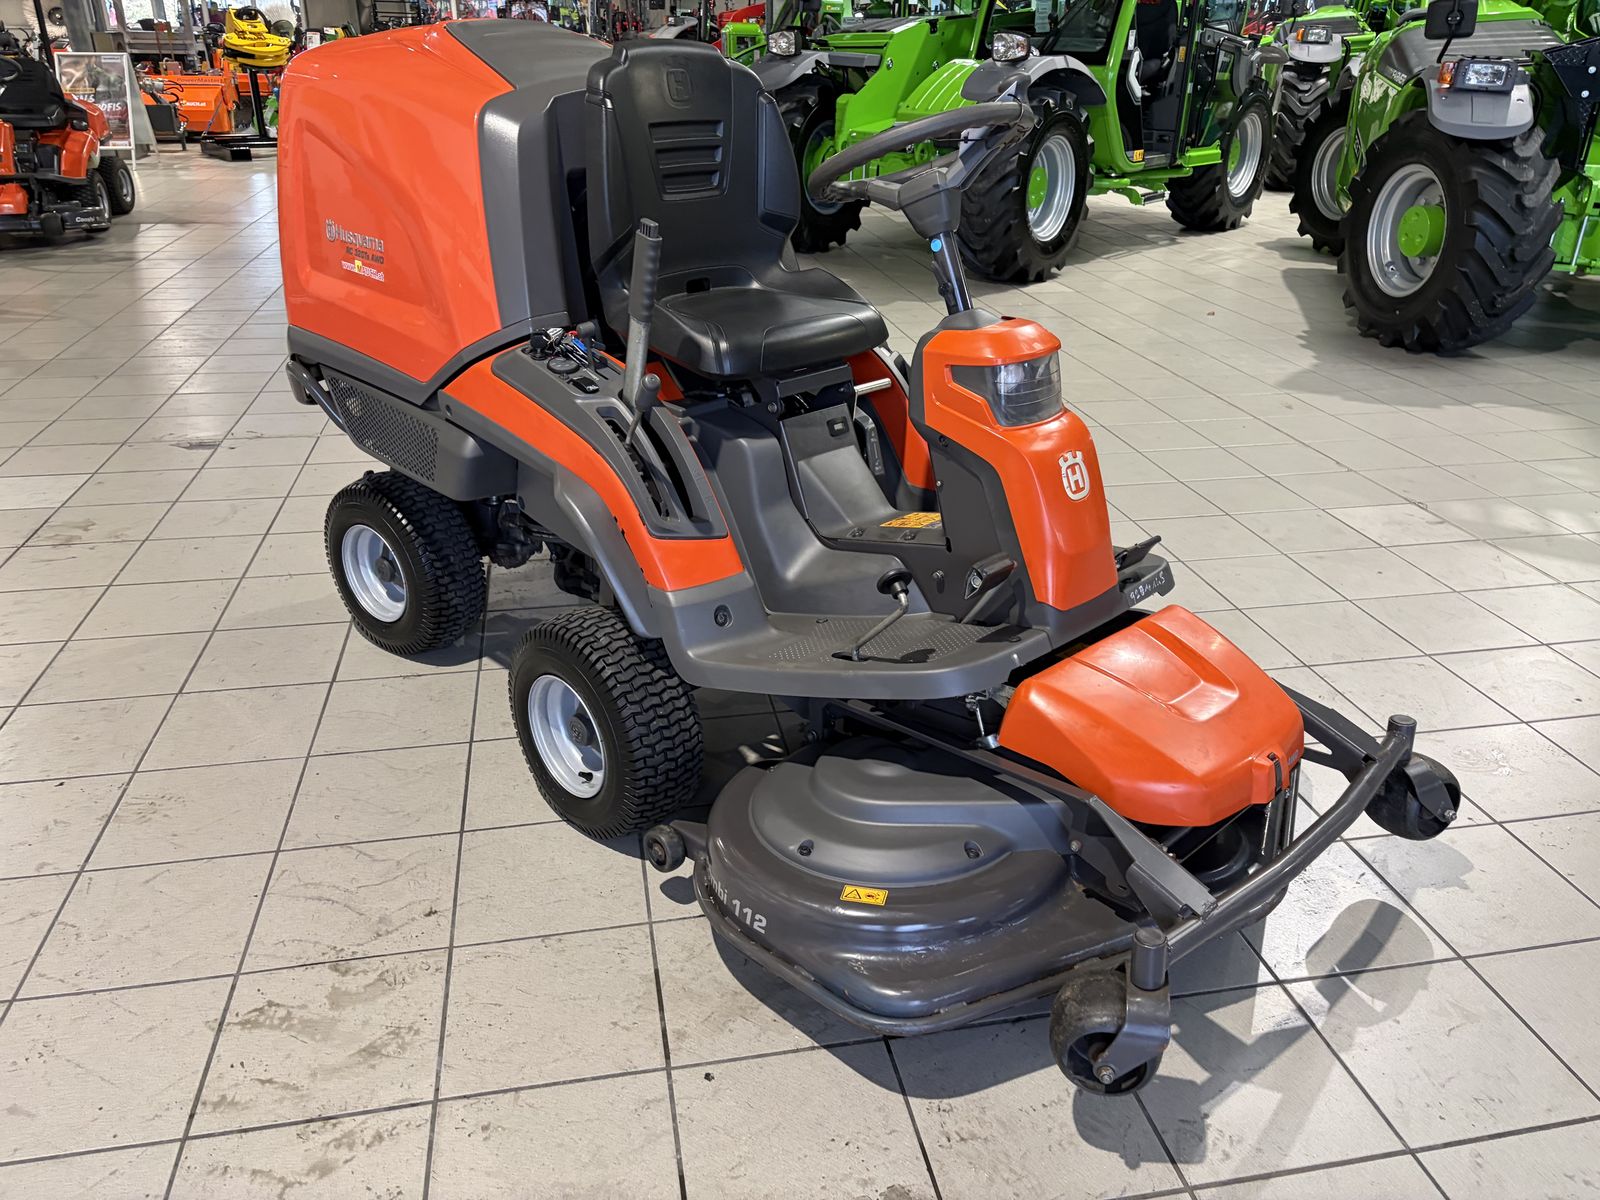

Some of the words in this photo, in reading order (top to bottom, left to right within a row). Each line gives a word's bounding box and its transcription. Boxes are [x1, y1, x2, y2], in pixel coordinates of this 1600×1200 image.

[335, 223, 384, 251] Husqvarna
[710, 876, 728, 905] mbi
[731, 898, 767, 935] 112
